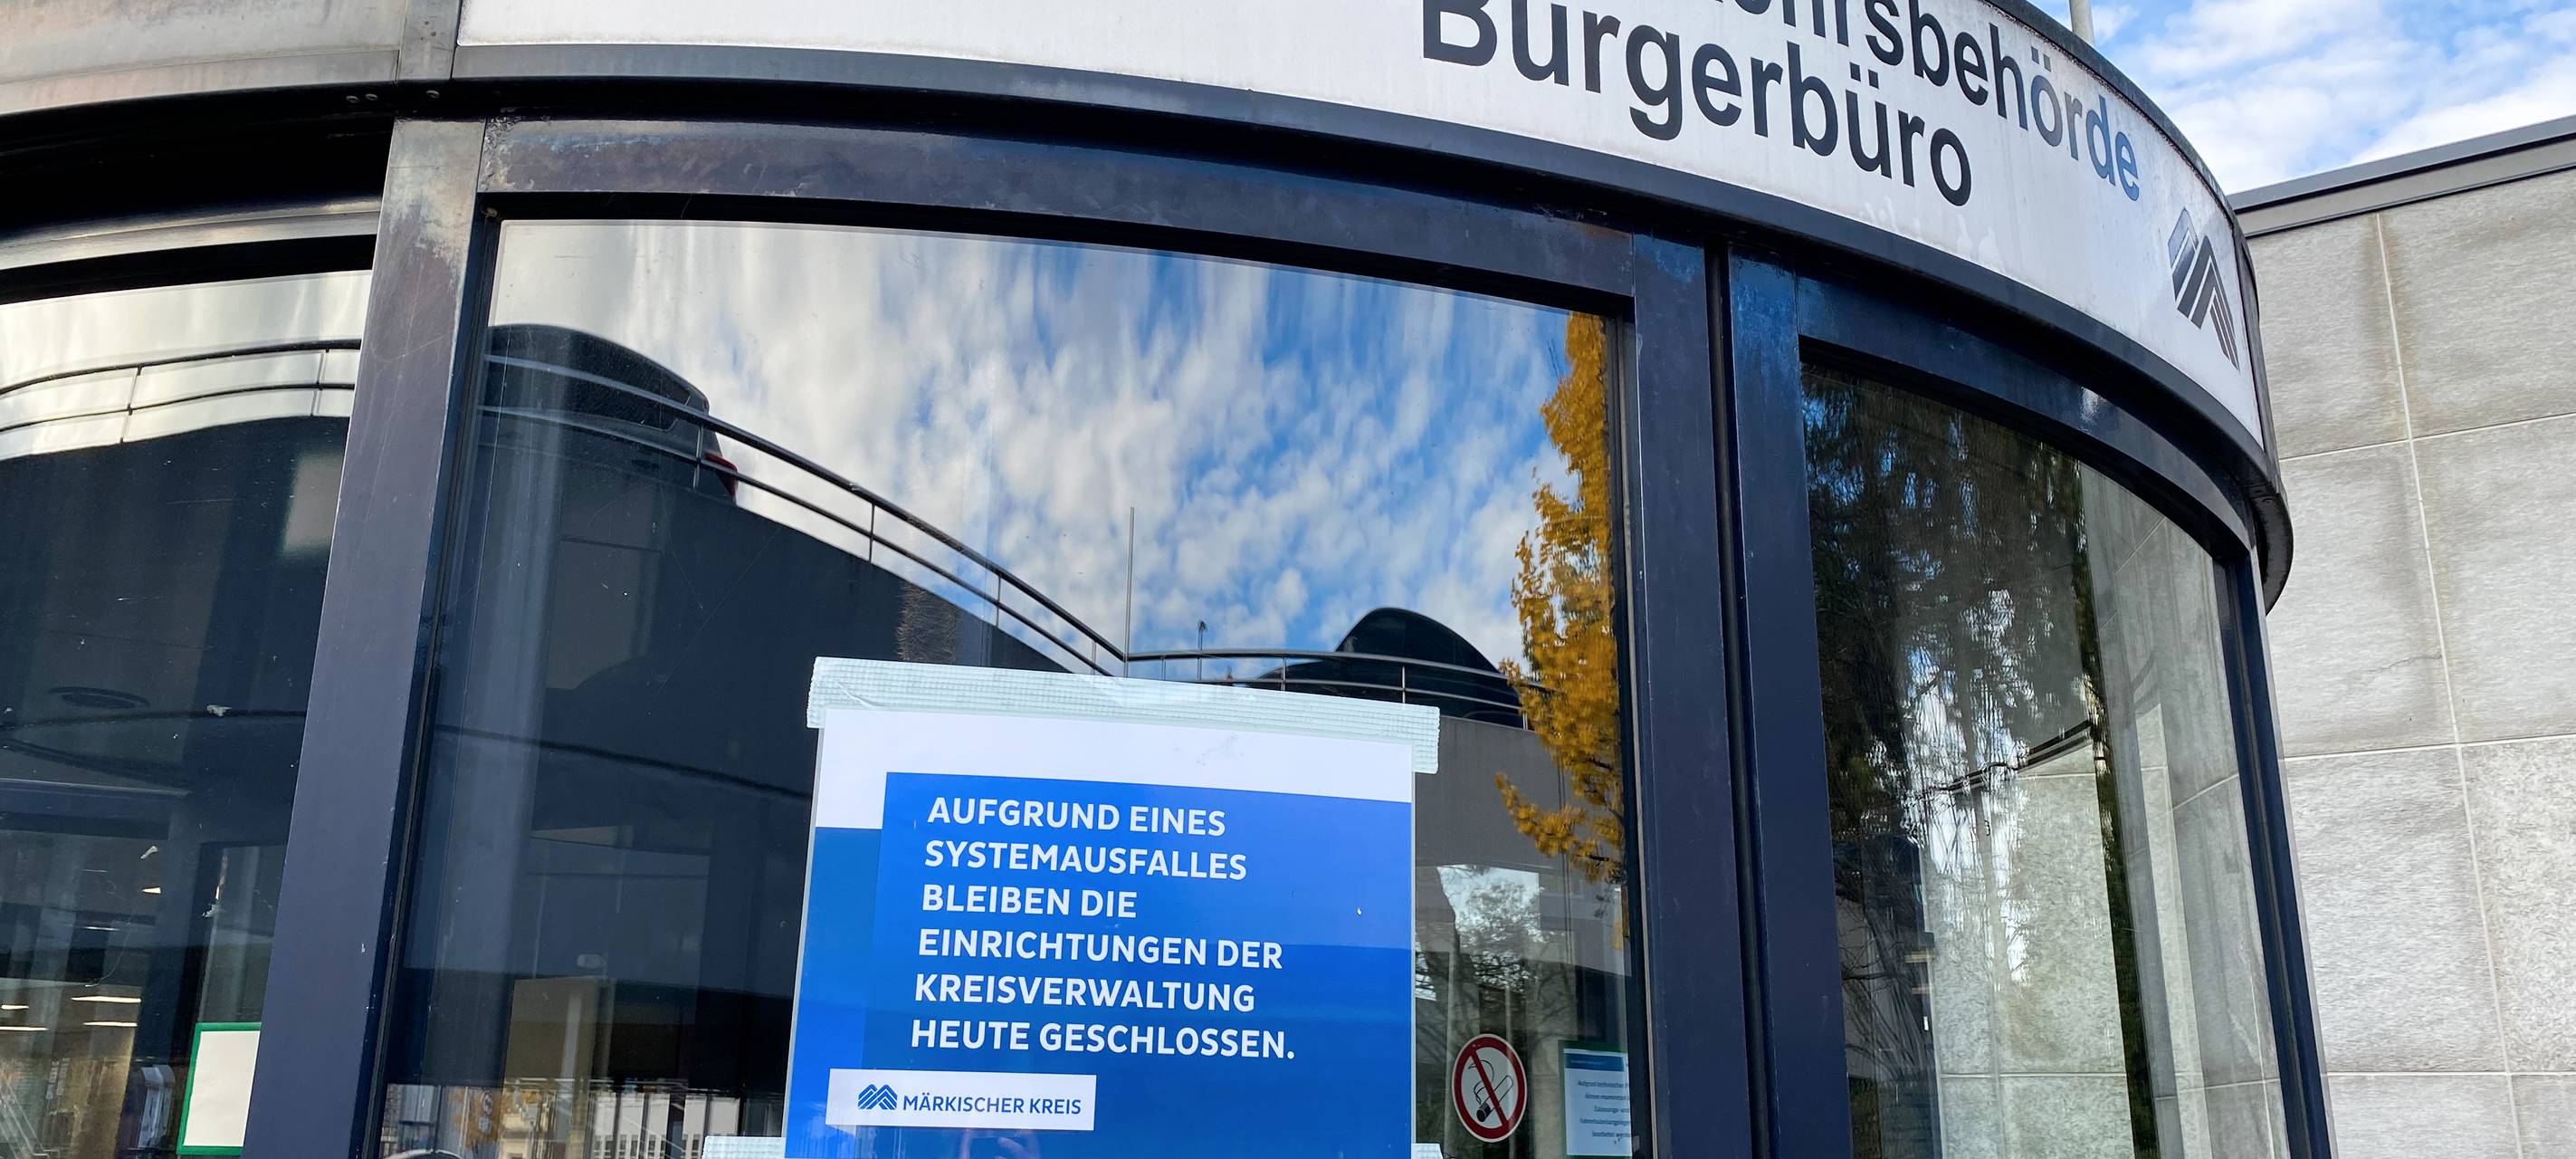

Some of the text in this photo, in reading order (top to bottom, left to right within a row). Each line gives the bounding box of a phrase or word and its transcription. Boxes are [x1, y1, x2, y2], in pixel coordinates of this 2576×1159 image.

[927, 798, 1226, 837] AUFGRUND EINES
[924, 840, 1246, 880] SYSTEMAUSFALLES
[922, 884, 1137, 918] BLEIBEN DIE
[919, 929, 1283, 969] EINRICHTUNGEN DER
[915, 974, 1255, 1012] KREISVERWALTUNG
[911, 1020, 1295, 1059] HEUTE GESCHLOSSEN.
[902, 1092, 1082, 1115] MÄRKISCHER KREIS
